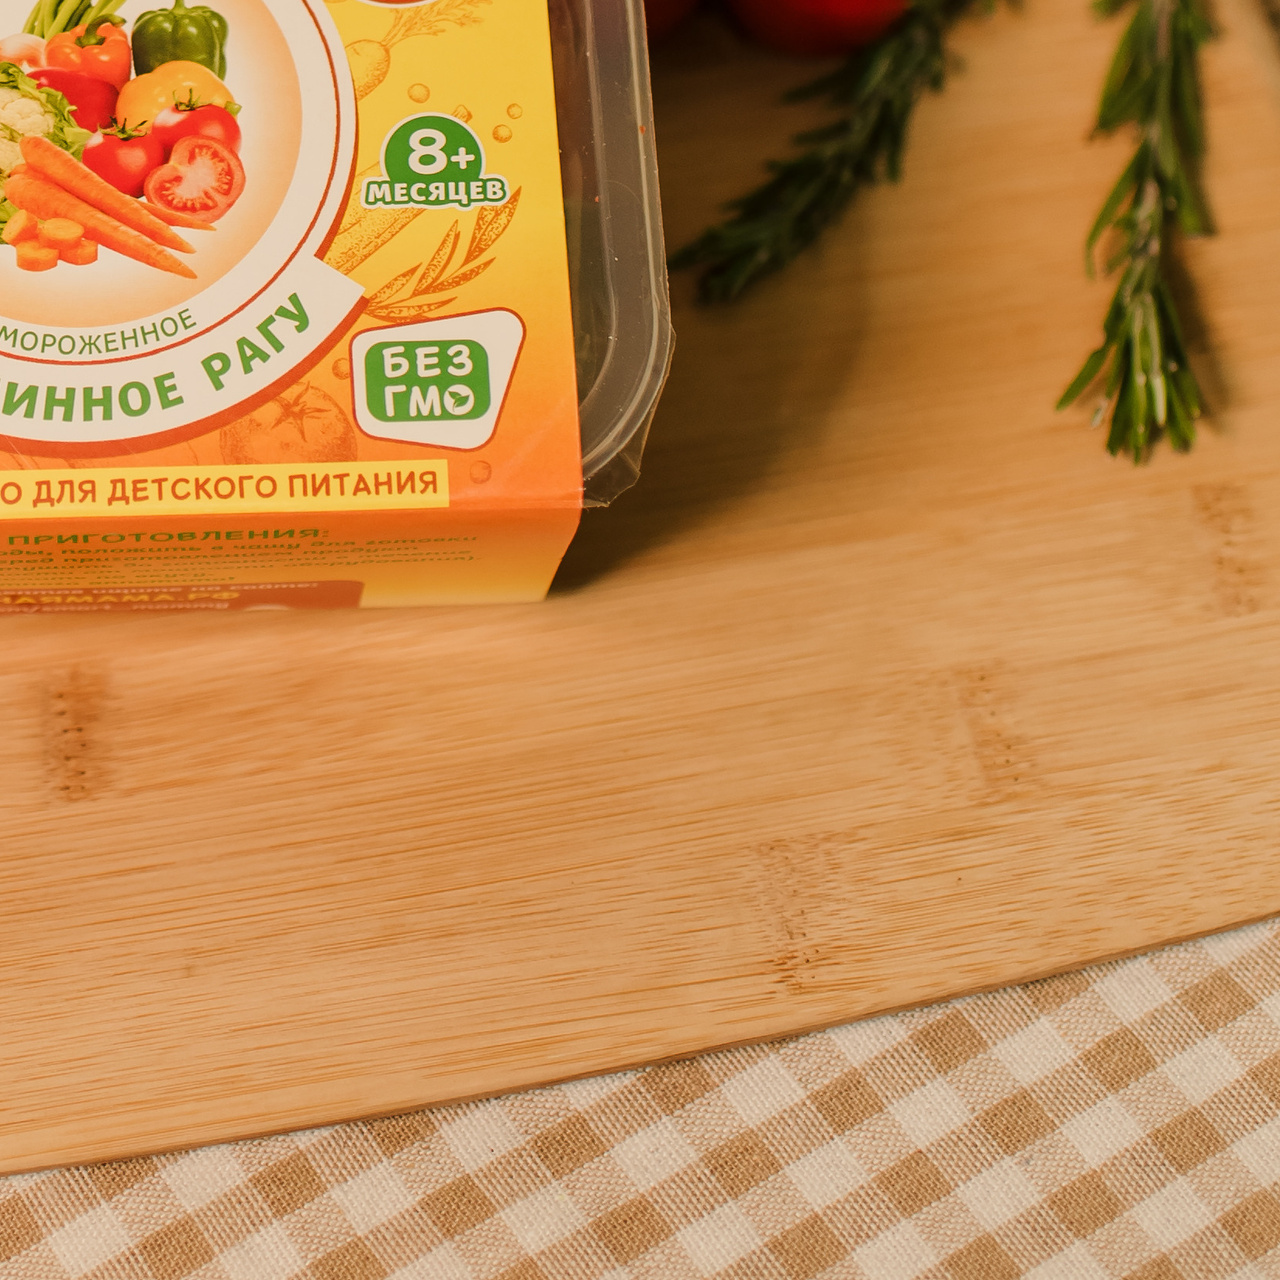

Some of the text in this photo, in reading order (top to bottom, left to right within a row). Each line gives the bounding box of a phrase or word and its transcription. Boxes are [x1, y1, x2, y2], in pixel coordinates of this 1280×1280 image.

[407, 128, 475, 174] 8+
[367, 178, 507, 205] МЕСЯЦЕВ
[201, 292, 311, 391] РАГУ
[382, 344, 474, 379] БЕЗ
[384, 384, 476, 418] ГМО
[32, 480, 97, 507] ДЛЯ
[107, 474, 278, 505] ДЕТСКОГО
[288, 470, 438, 499] ПИТАНИЯ
[8, 528, 330, 546] ПРИГОТОВЛЕНИЯ:
[61, 546, 201, 554] положить
[366, 535, 476, 545] готовки
